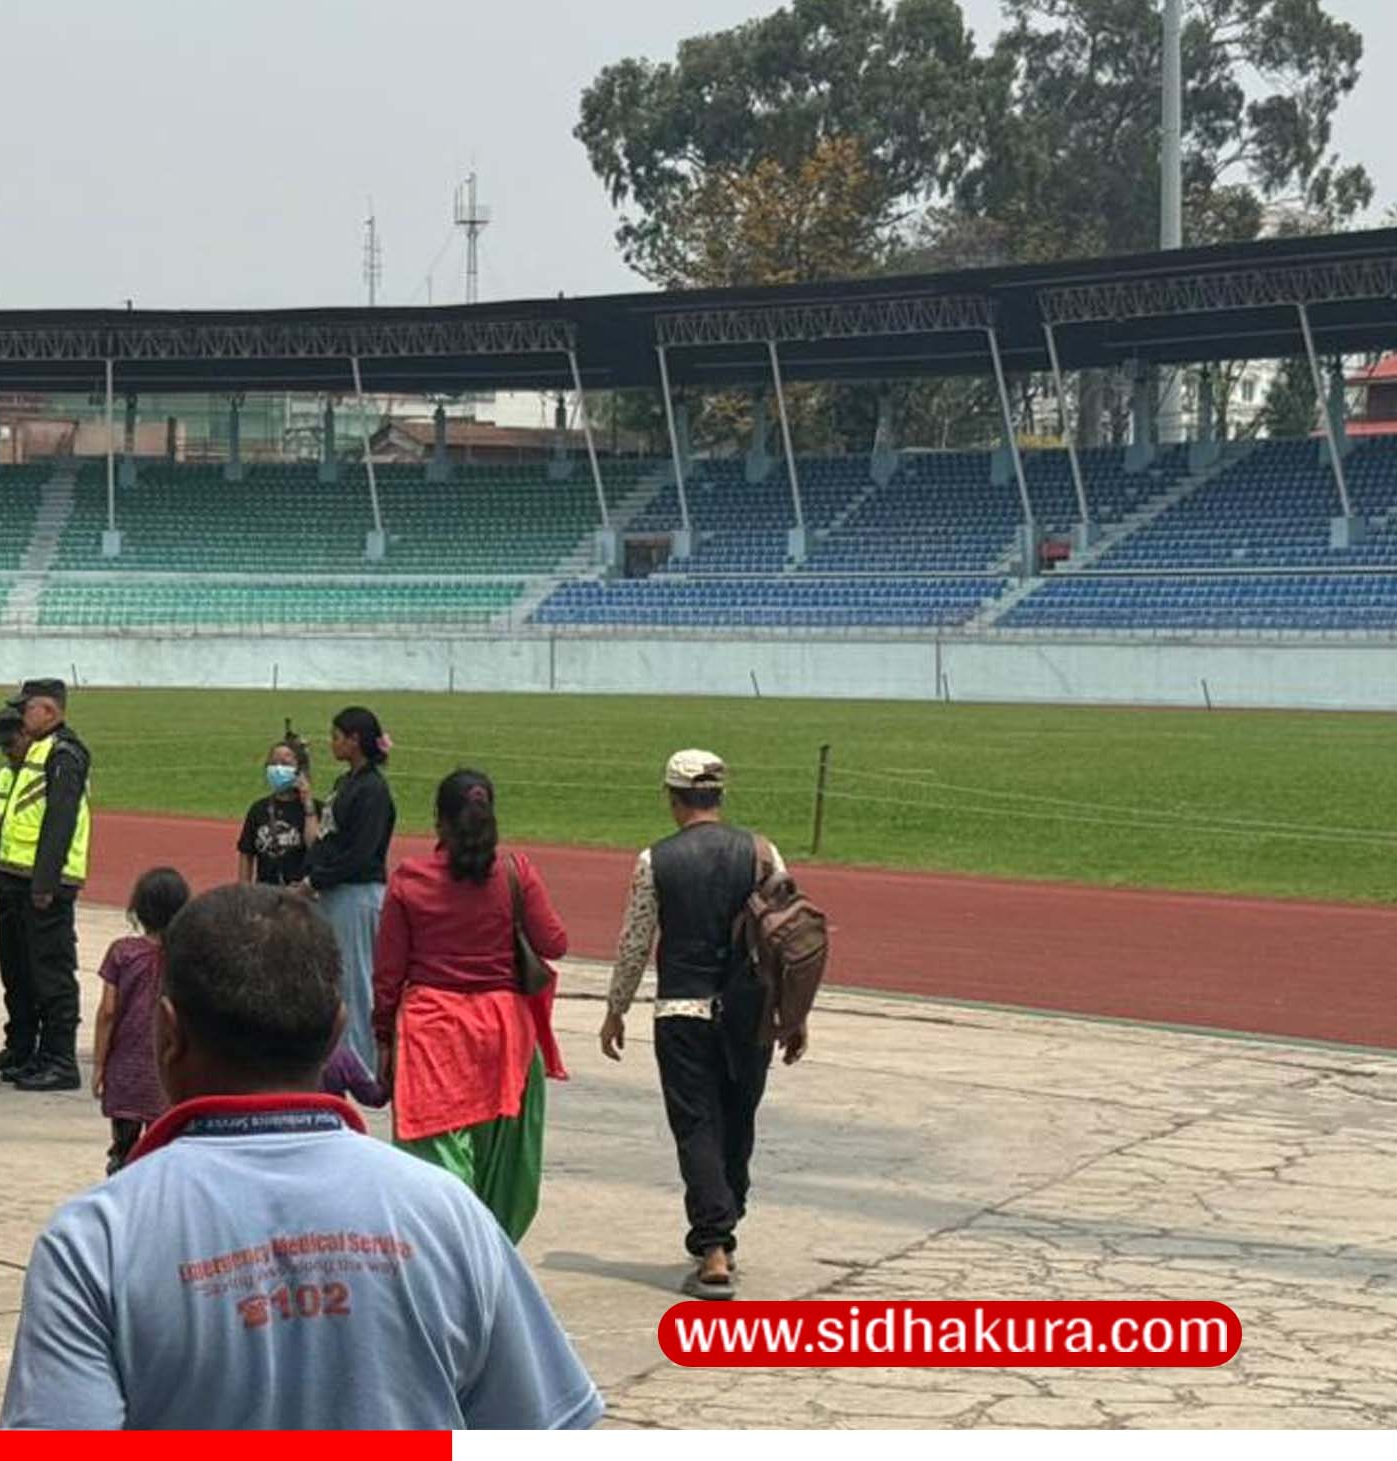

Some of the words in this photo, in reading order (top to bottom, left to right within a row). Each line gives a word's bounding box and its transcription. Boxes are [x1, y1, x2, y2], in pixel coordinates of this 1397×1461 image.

[177, 1243, 270, 1282] Emergency
[272, 1231, 345, 1258] Medical
[346, 1231, 413, 1260] Servie
[271, 1281, 351, 1320] 102
